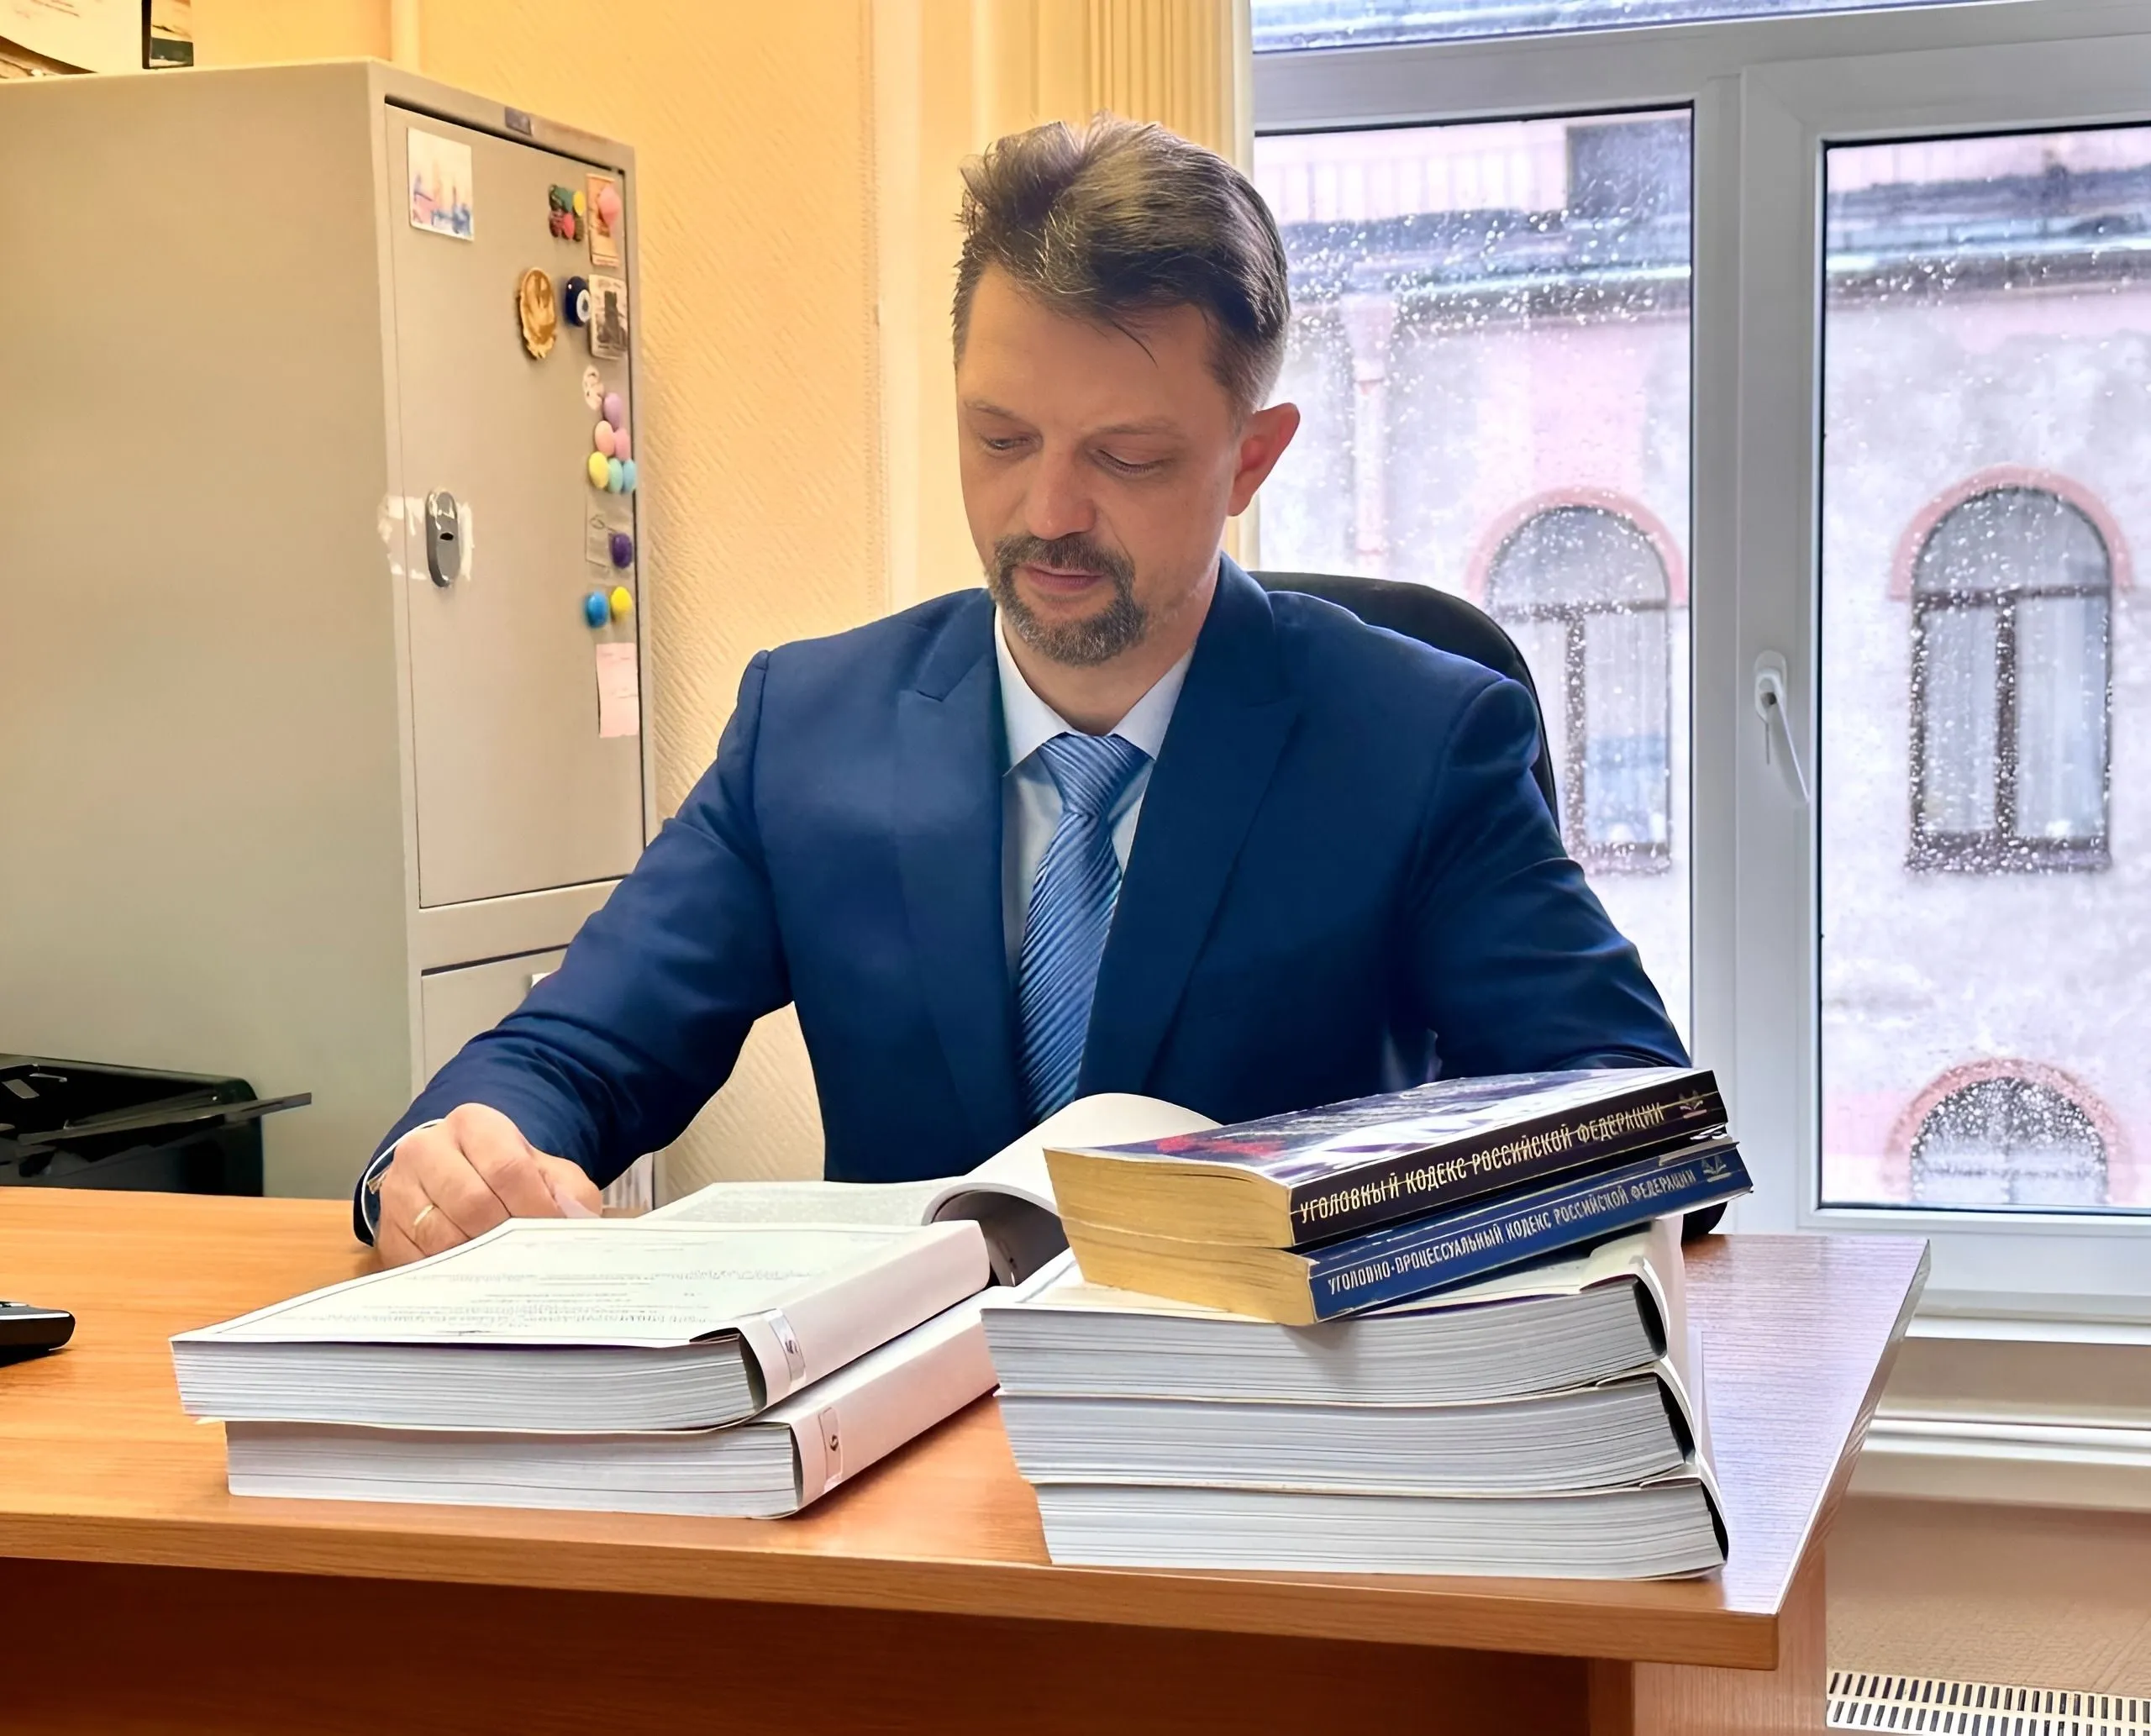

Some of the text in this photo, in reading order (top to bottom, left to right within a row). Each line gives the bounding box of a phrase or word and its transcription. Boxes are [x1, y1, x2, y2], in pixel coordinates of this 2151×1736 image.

[1300, 1102, 1665, 1223] УГОЛОВНЫЙ КОДЕКС РОССИЙСКОЙ ФЕДЕРАЦИИ
[1507, 1213, 1552, 1239] КОДЕКС
[1554, 1188, 1629, 1225] РОССИЙСКОЙ
[1631, 1169, 1696, 1200] ФЕДЕРАЦИИ
